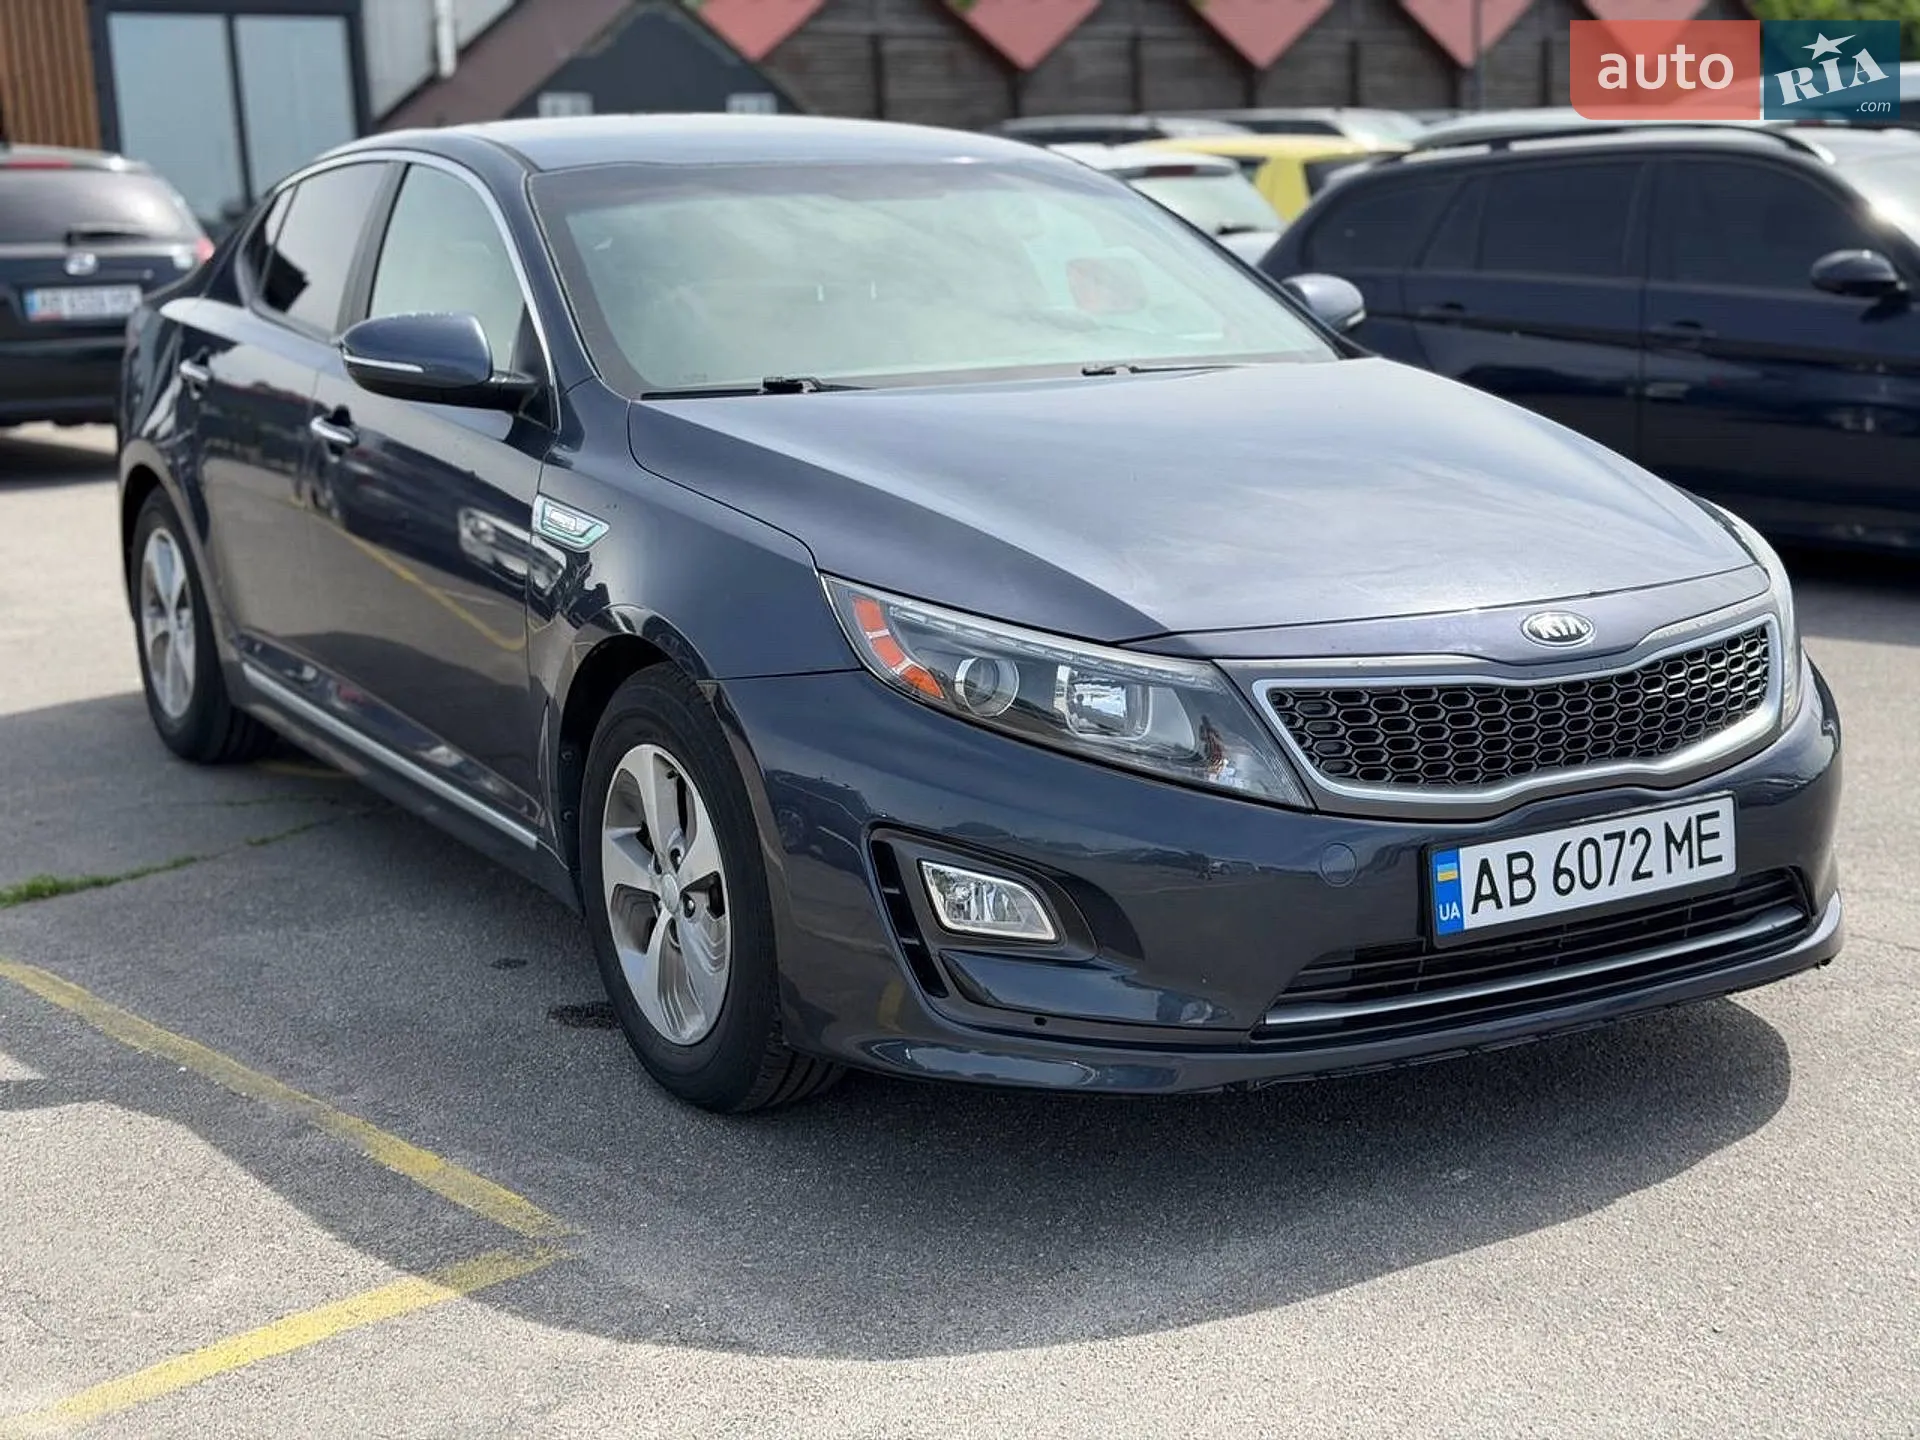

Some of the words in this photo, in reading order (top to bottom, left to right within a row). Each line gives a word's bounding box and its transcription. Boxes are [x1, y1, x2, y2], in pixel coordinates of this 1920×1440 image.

[1470, 850, 1537, 915] AB
[1552, 826, 1653, 897] 6072
[1663, 811, 1723, 874] ME
[1438, 904, 1461, 922] UA
